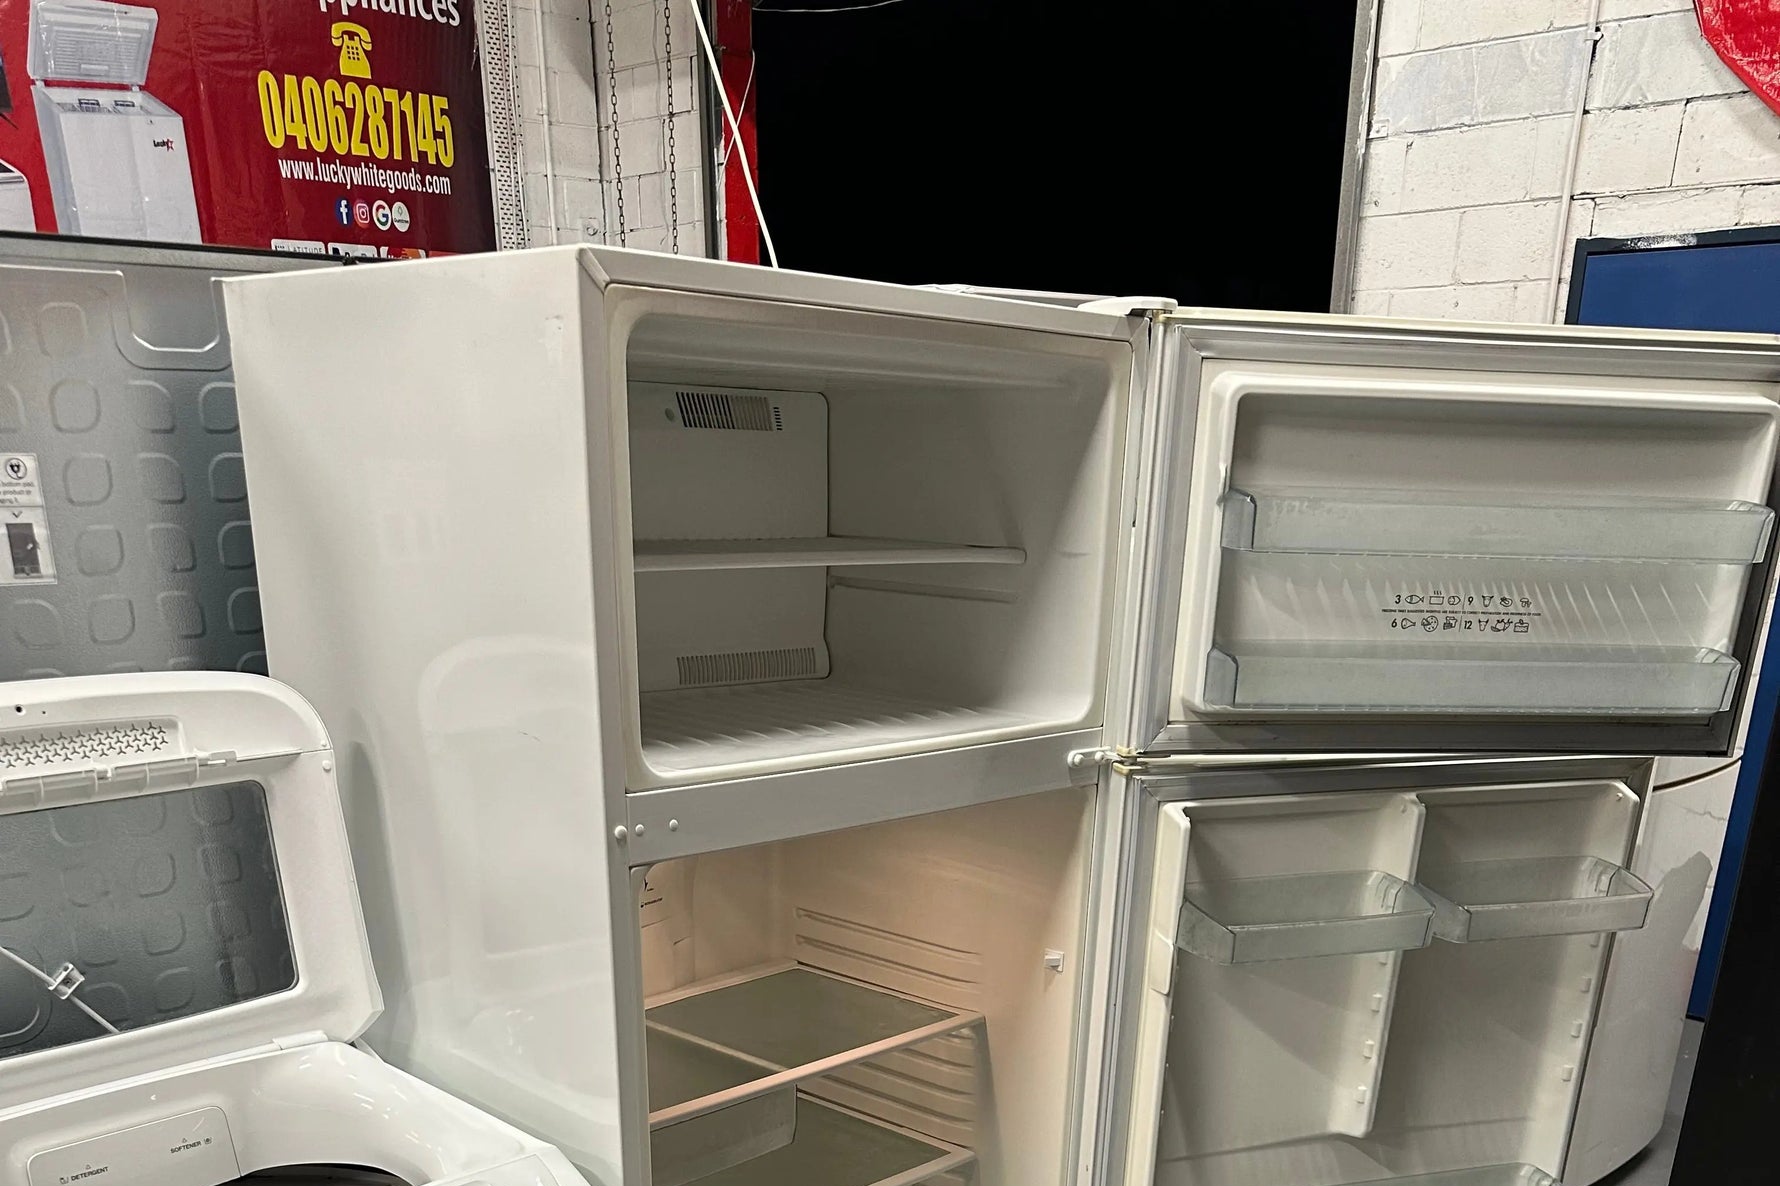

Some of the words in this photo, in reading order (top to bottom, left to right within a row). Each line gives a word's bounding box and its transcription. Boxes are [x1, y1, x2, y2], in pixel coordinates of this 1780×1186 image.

[320, 0, 460, 27] ppances
[257, 70, 455, 168] 0406287145
[278, 156, 452, 196] www.luckywhitegoods.com
[1394, 594, 1402, 605] 3
[1467, 595, 1474, 605] 9
[1391, 618, 1398, 629] 6
[1464, 620, 1473, 630] 12
[170, 1140, 202, 1154] SOFTENER
[70, 1166, 109, 1182] DETERGENT
